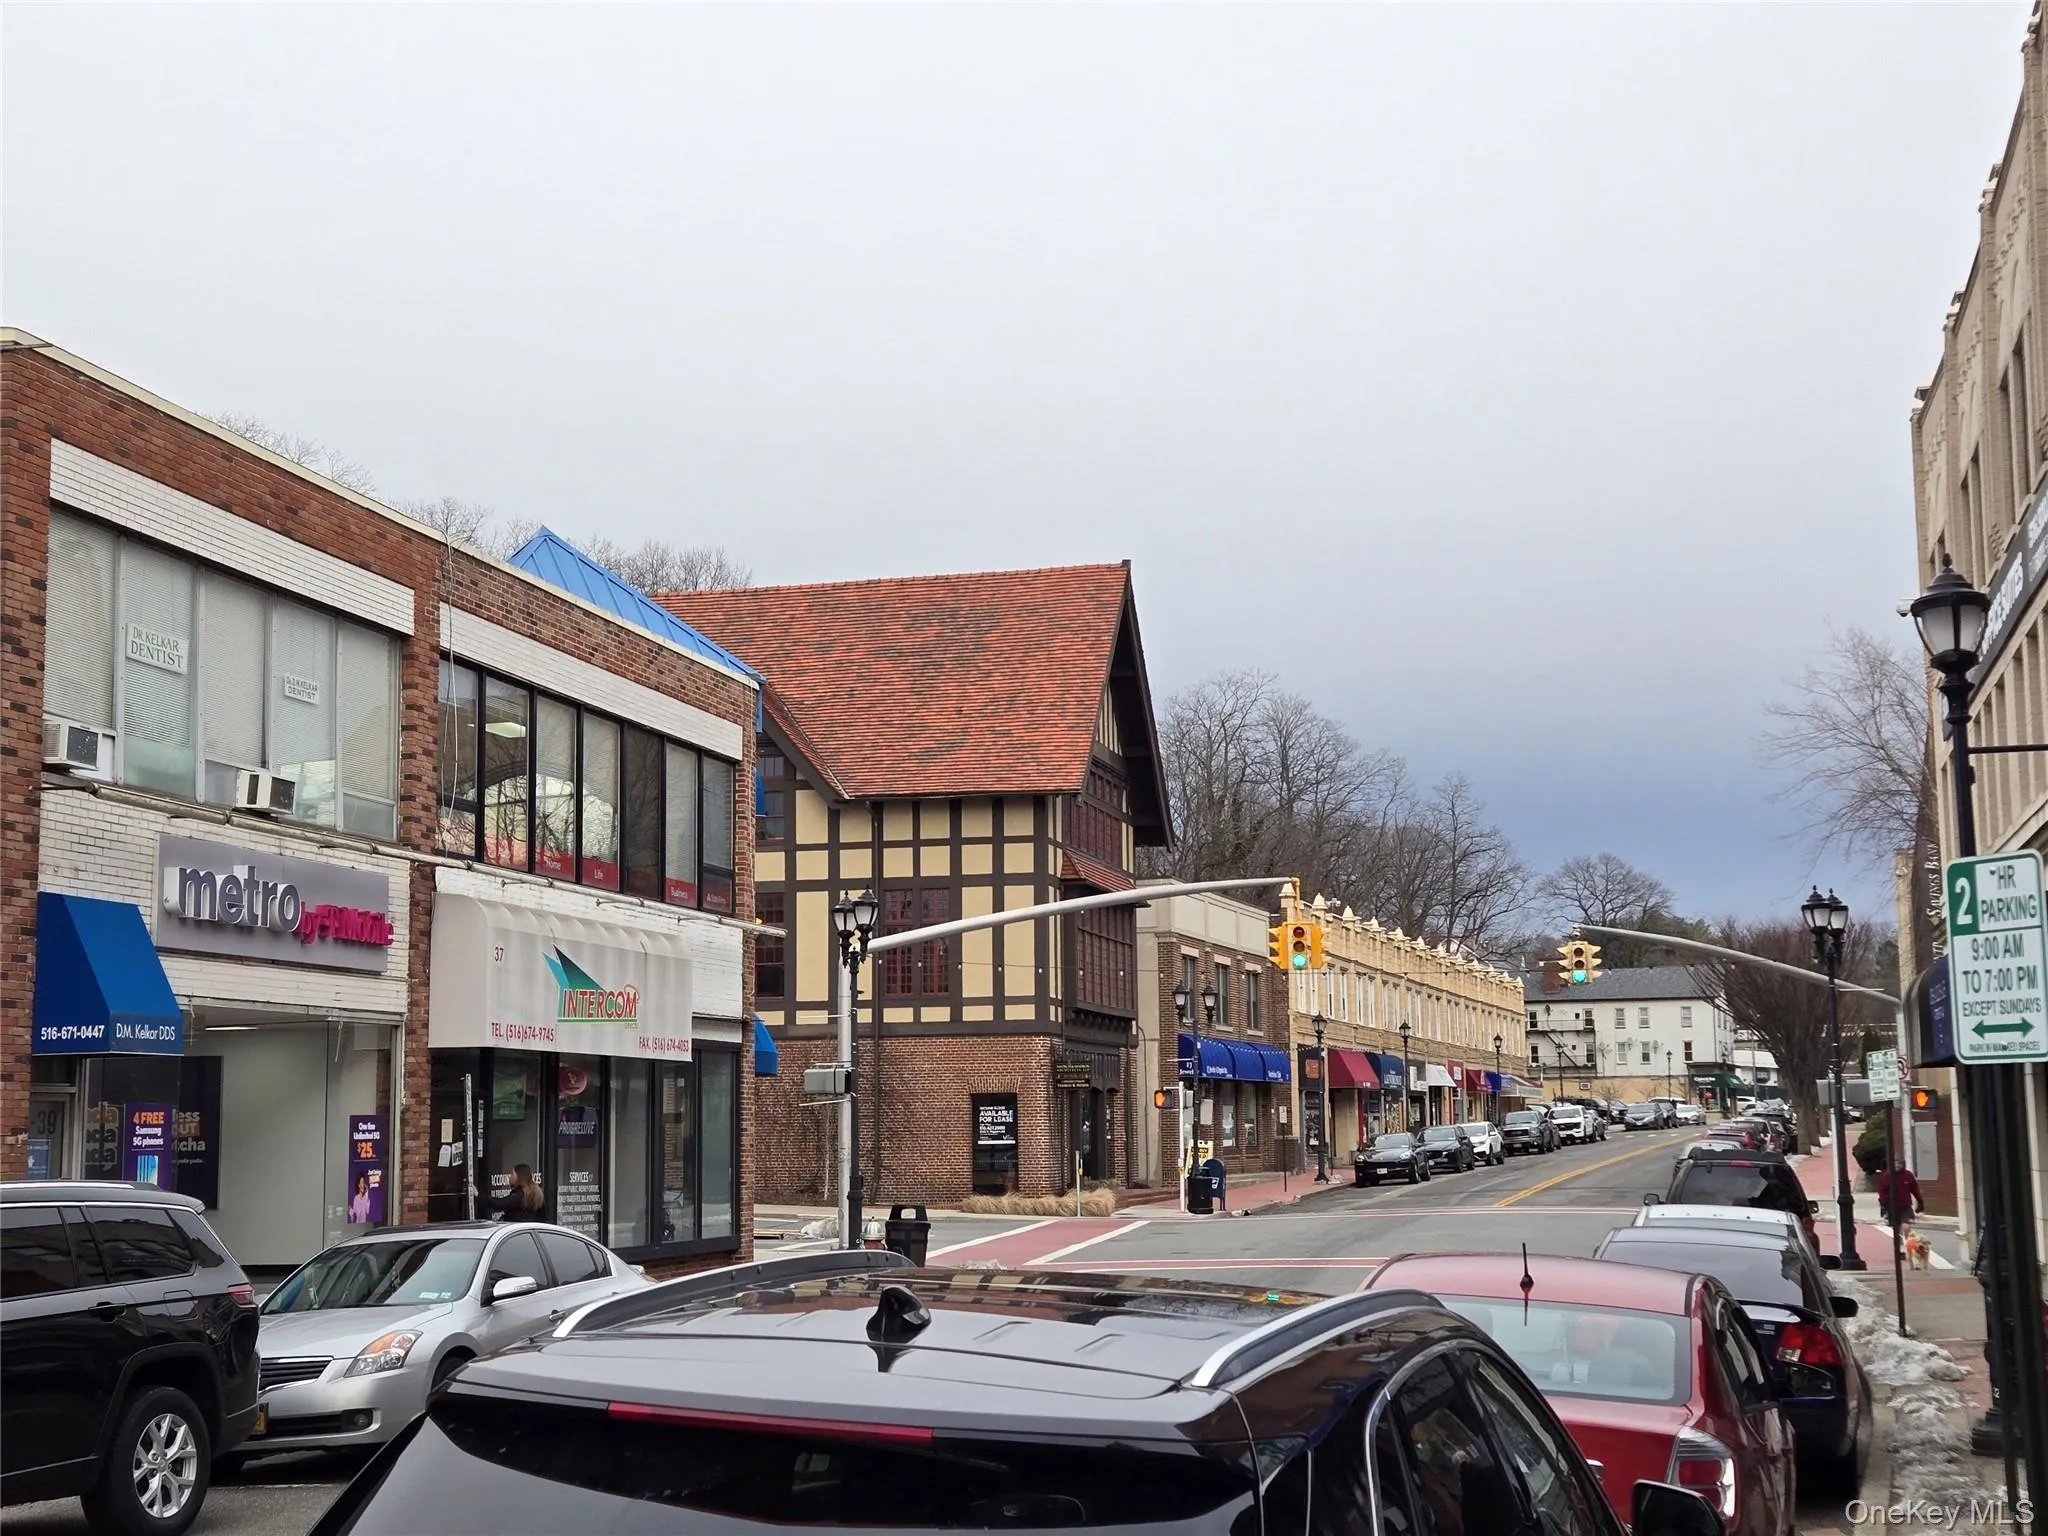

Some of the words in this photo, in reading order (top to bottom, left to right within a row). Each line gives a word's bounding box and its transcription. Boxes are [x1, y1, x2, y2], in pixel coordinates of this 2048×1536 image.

[145, 631, 180, 653] KELKAR
[131, 639, 184, 669] DENTIST
[287, 685, 316, 700] DENTIST
[170, 865, 301, 933] metro
[1954, 876, 1974, 926] 2
[1997, 864, 2017, 891] HR
[1980, 894, 2038, 924] PARKING
[494, 946, 505, 962] 37
[1971, 935, 2000, 961] 9:00
[2003, 933, 2025, 959] AM
[1962, 969, 1982, 995] TO
[1985, 967, 2014, 993] 7:00
[2016, 964, 2039, 991] PM
[562, 989, 637, 1019] INTERCOM
[1962, 1000, 1997, 1018] EXCEPT
[1999, 997, 2042, 1015] SUNDAYS
[40, 1025, 105, 1041] 516-671-0447
[135, 1024, 159, 1040] Kelkar
[159, 1025, 176, 1041] DDS
[37, 1110, 57, 1135] 39
[132, 1111, 140, 1125] 4
[140, 1111, 165, 1125] FREE
[558, 1121, 596, 1135] PROGRESSIVE
[135, 1125, 162, 1137] Samsung
[142, 1136, 164, 1148] phones
[569, 1171, 589, 1183] SERVICES
